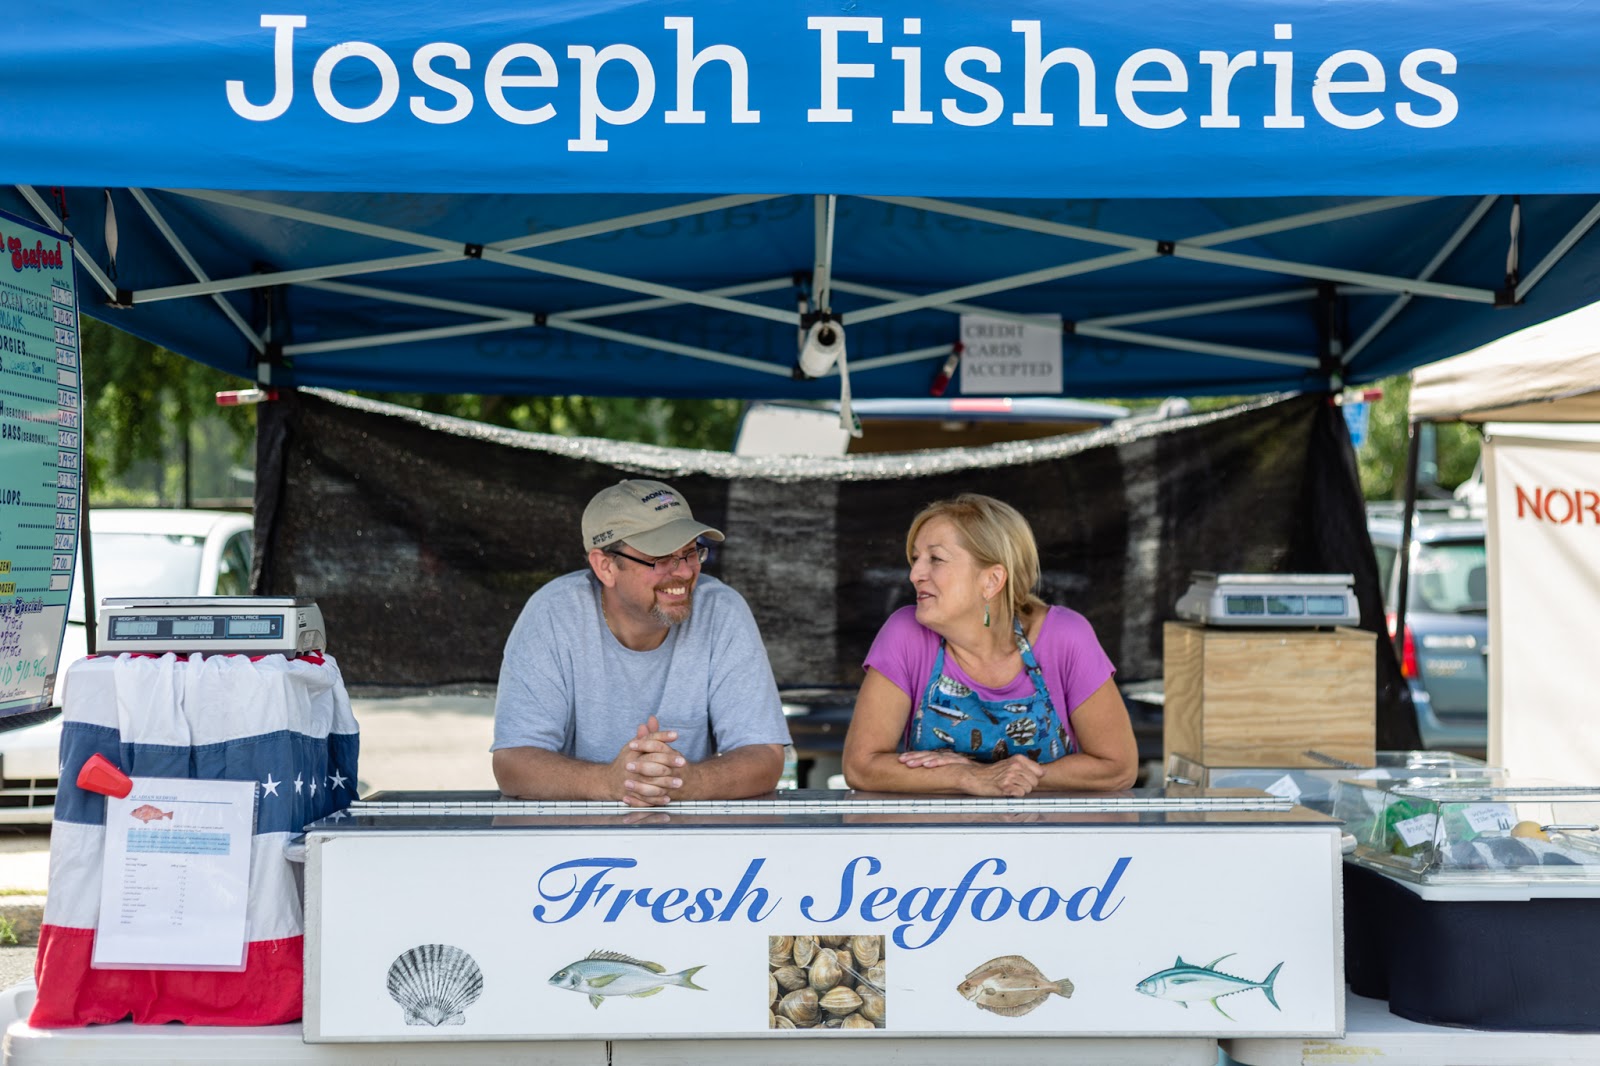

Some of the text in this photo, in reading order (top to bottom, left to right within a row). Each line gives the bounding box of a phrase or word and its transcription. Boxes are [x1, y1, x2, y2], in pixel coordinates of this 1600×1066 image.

[225, 14, 1459, 152] Joseph Fisheries
[7, 236, 63, 272] Seafood
[965, 323, 1024, 339] CREDIT
[966, 342, 1022, 358] CARDS
[968, 362, 1053, 377] ACCEPTED
[2, 423, 21, 441] BASS
[655, 503, 670, 512] NEW
[15, 597, 43, 618] Specials
[533, 855, 1133, 950] Fresh Seafood
